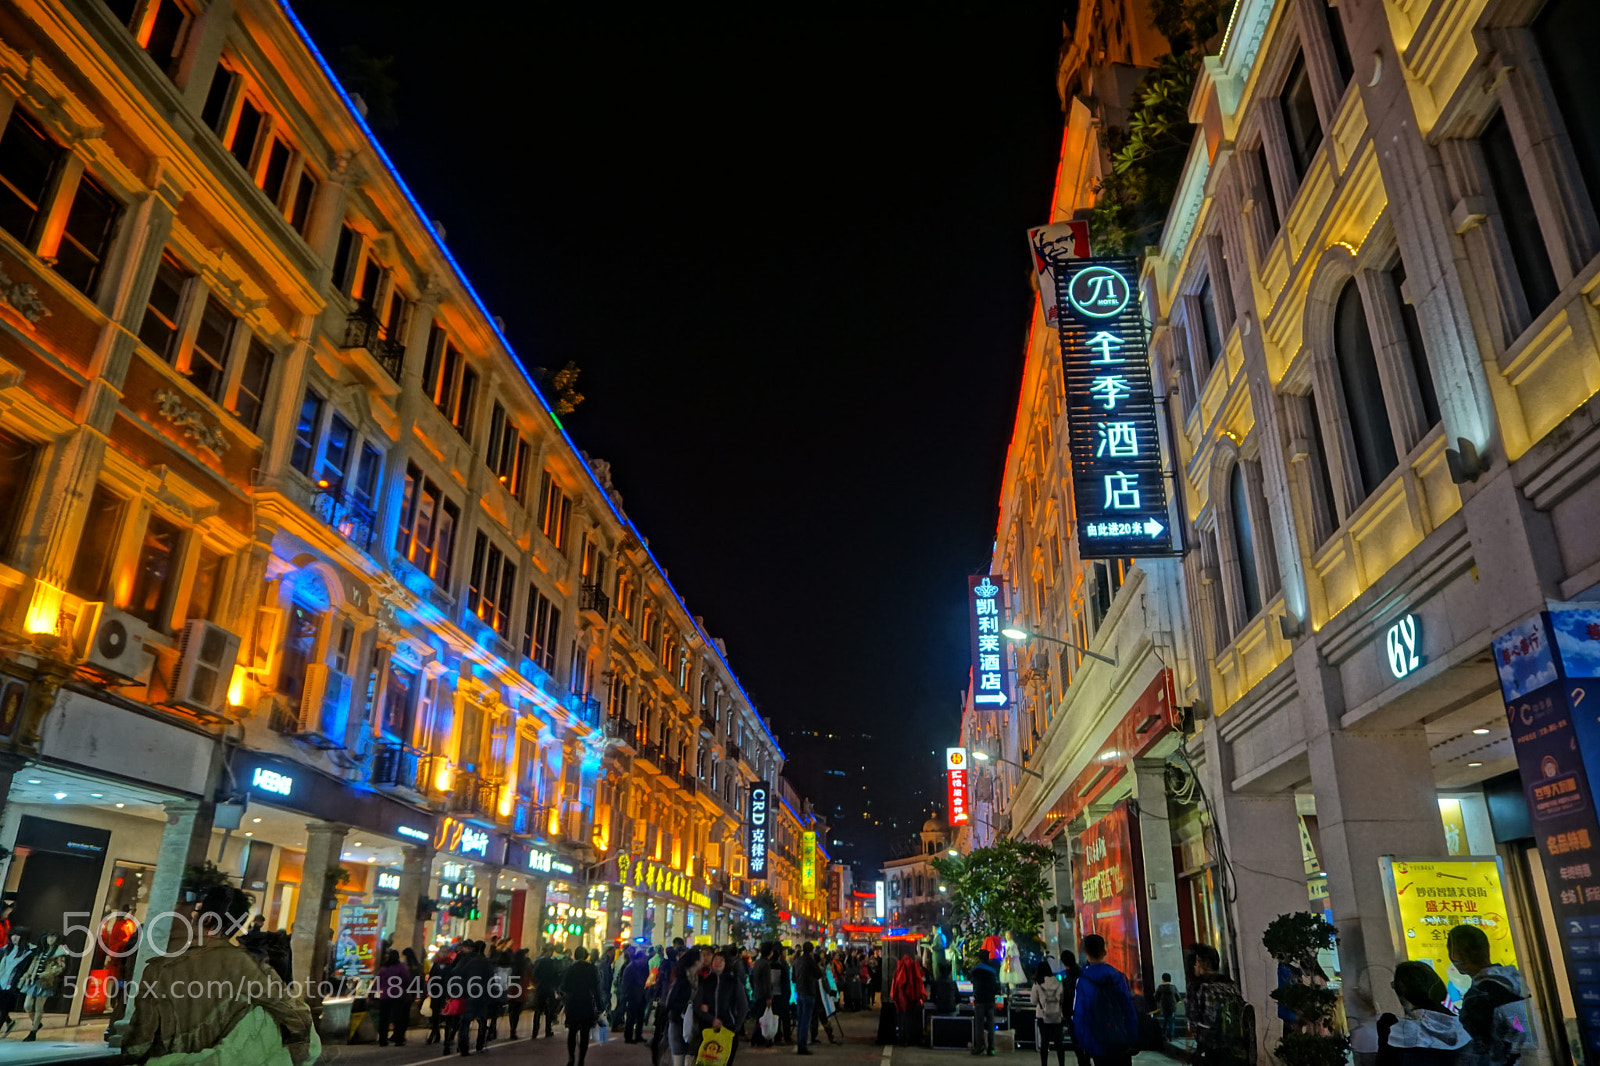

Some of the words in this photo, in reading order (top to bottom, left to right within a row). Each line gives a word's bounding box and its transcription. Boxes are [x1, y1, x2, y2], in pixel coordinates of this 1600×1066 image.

[1097, 298, 1120, 306] HOTEL
[1085, 330, 1141, 511] 全季酒店
[1086, 521, 1143, 538] 由此进20米
[976, 598, 1002, 690] 凯利莱酒店
[752, 788, 766, 826] CRD
[1425, 900, 1478, 913] 盛大开业
